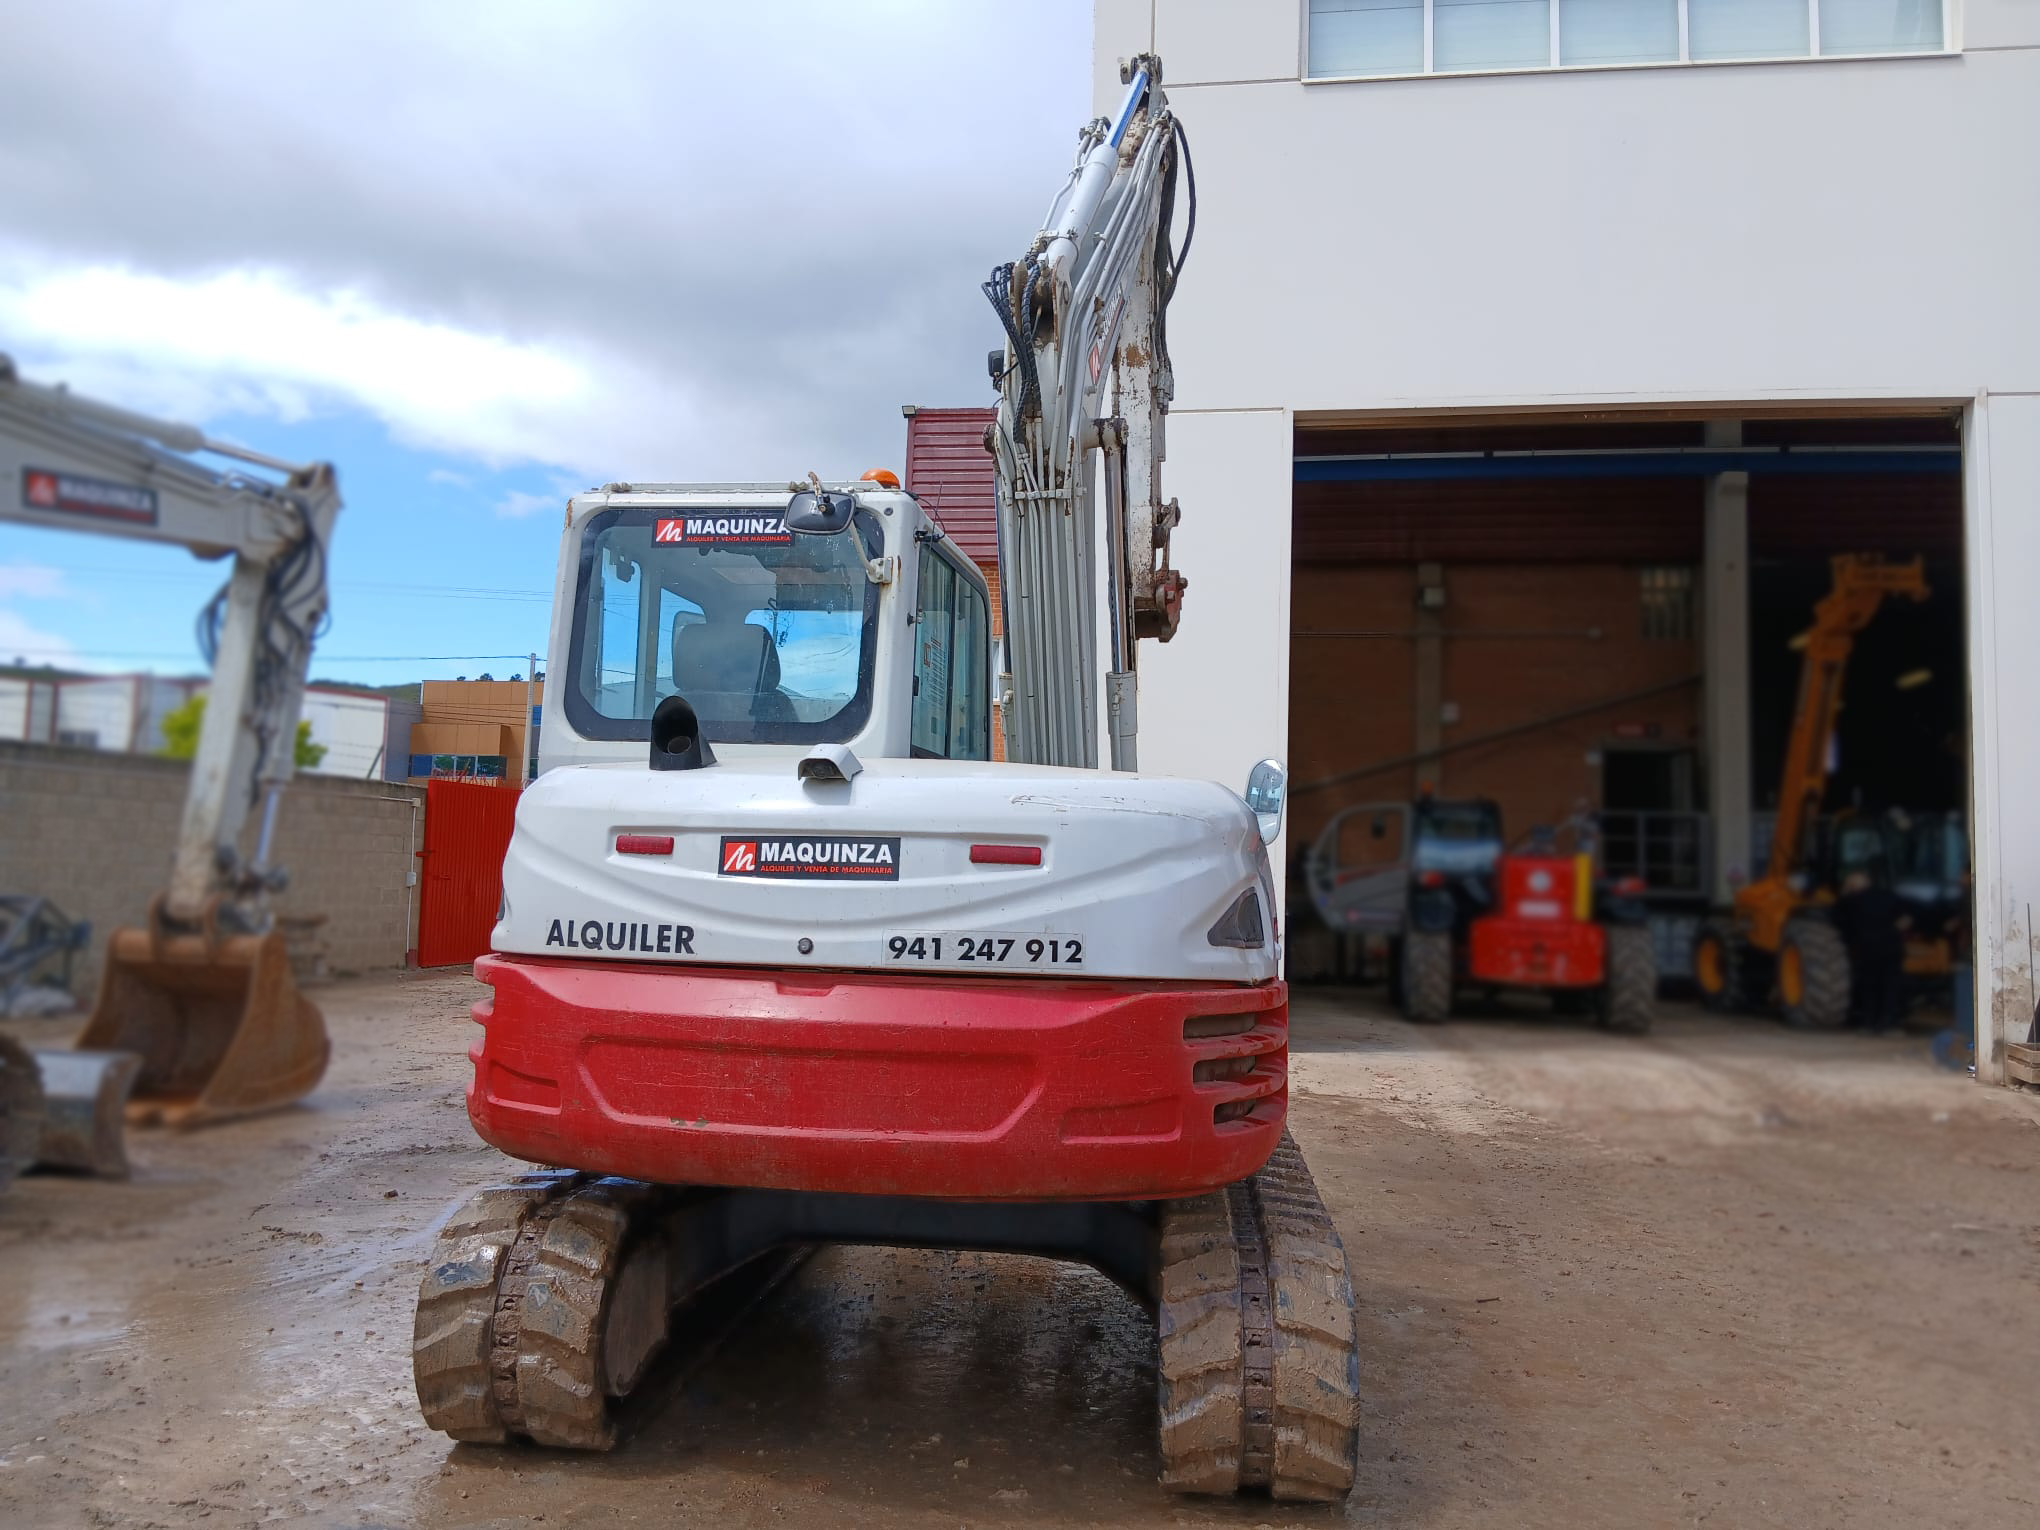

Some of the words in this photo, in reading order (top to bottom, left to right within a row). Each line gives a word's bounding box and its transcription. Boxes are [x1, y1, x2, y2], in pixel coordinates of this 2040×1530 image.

[760, 842, 893, 864] MAQUINZA
[760, 865, 795, 873] ALQUILER
[545, 919, 695, 954] ALQUILER
[888, 936, 942, 960] 941
[957, 937, 1016, 962] 247
[1025, 939, 1083, 963] 912
